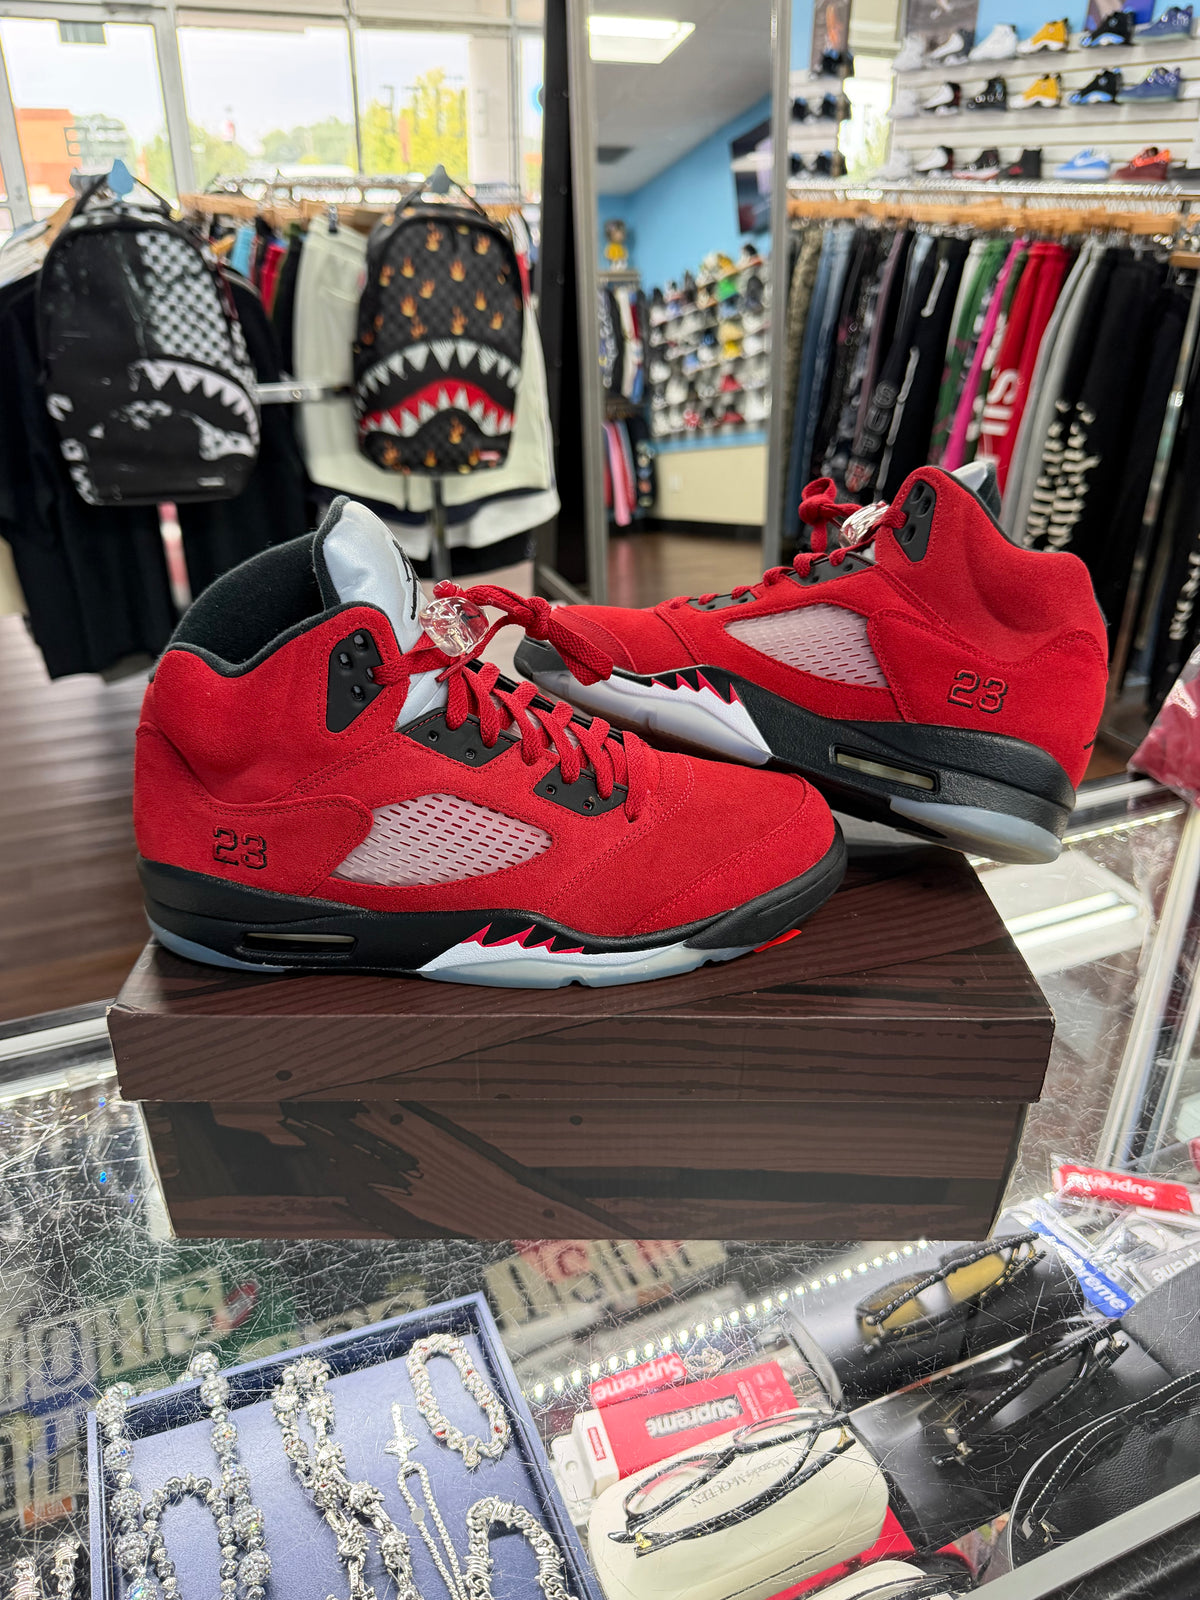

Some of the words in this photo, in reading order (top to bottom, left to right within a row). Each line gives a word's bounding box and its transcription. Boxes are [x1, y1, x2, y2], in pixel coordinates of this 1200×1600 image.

[946, 669, 1009, 714] 23
[212, 825, 267, 869] 23
[593, 1355, 684, 1401] Supreme
[645, 1398, 739, 1438] Supreme
